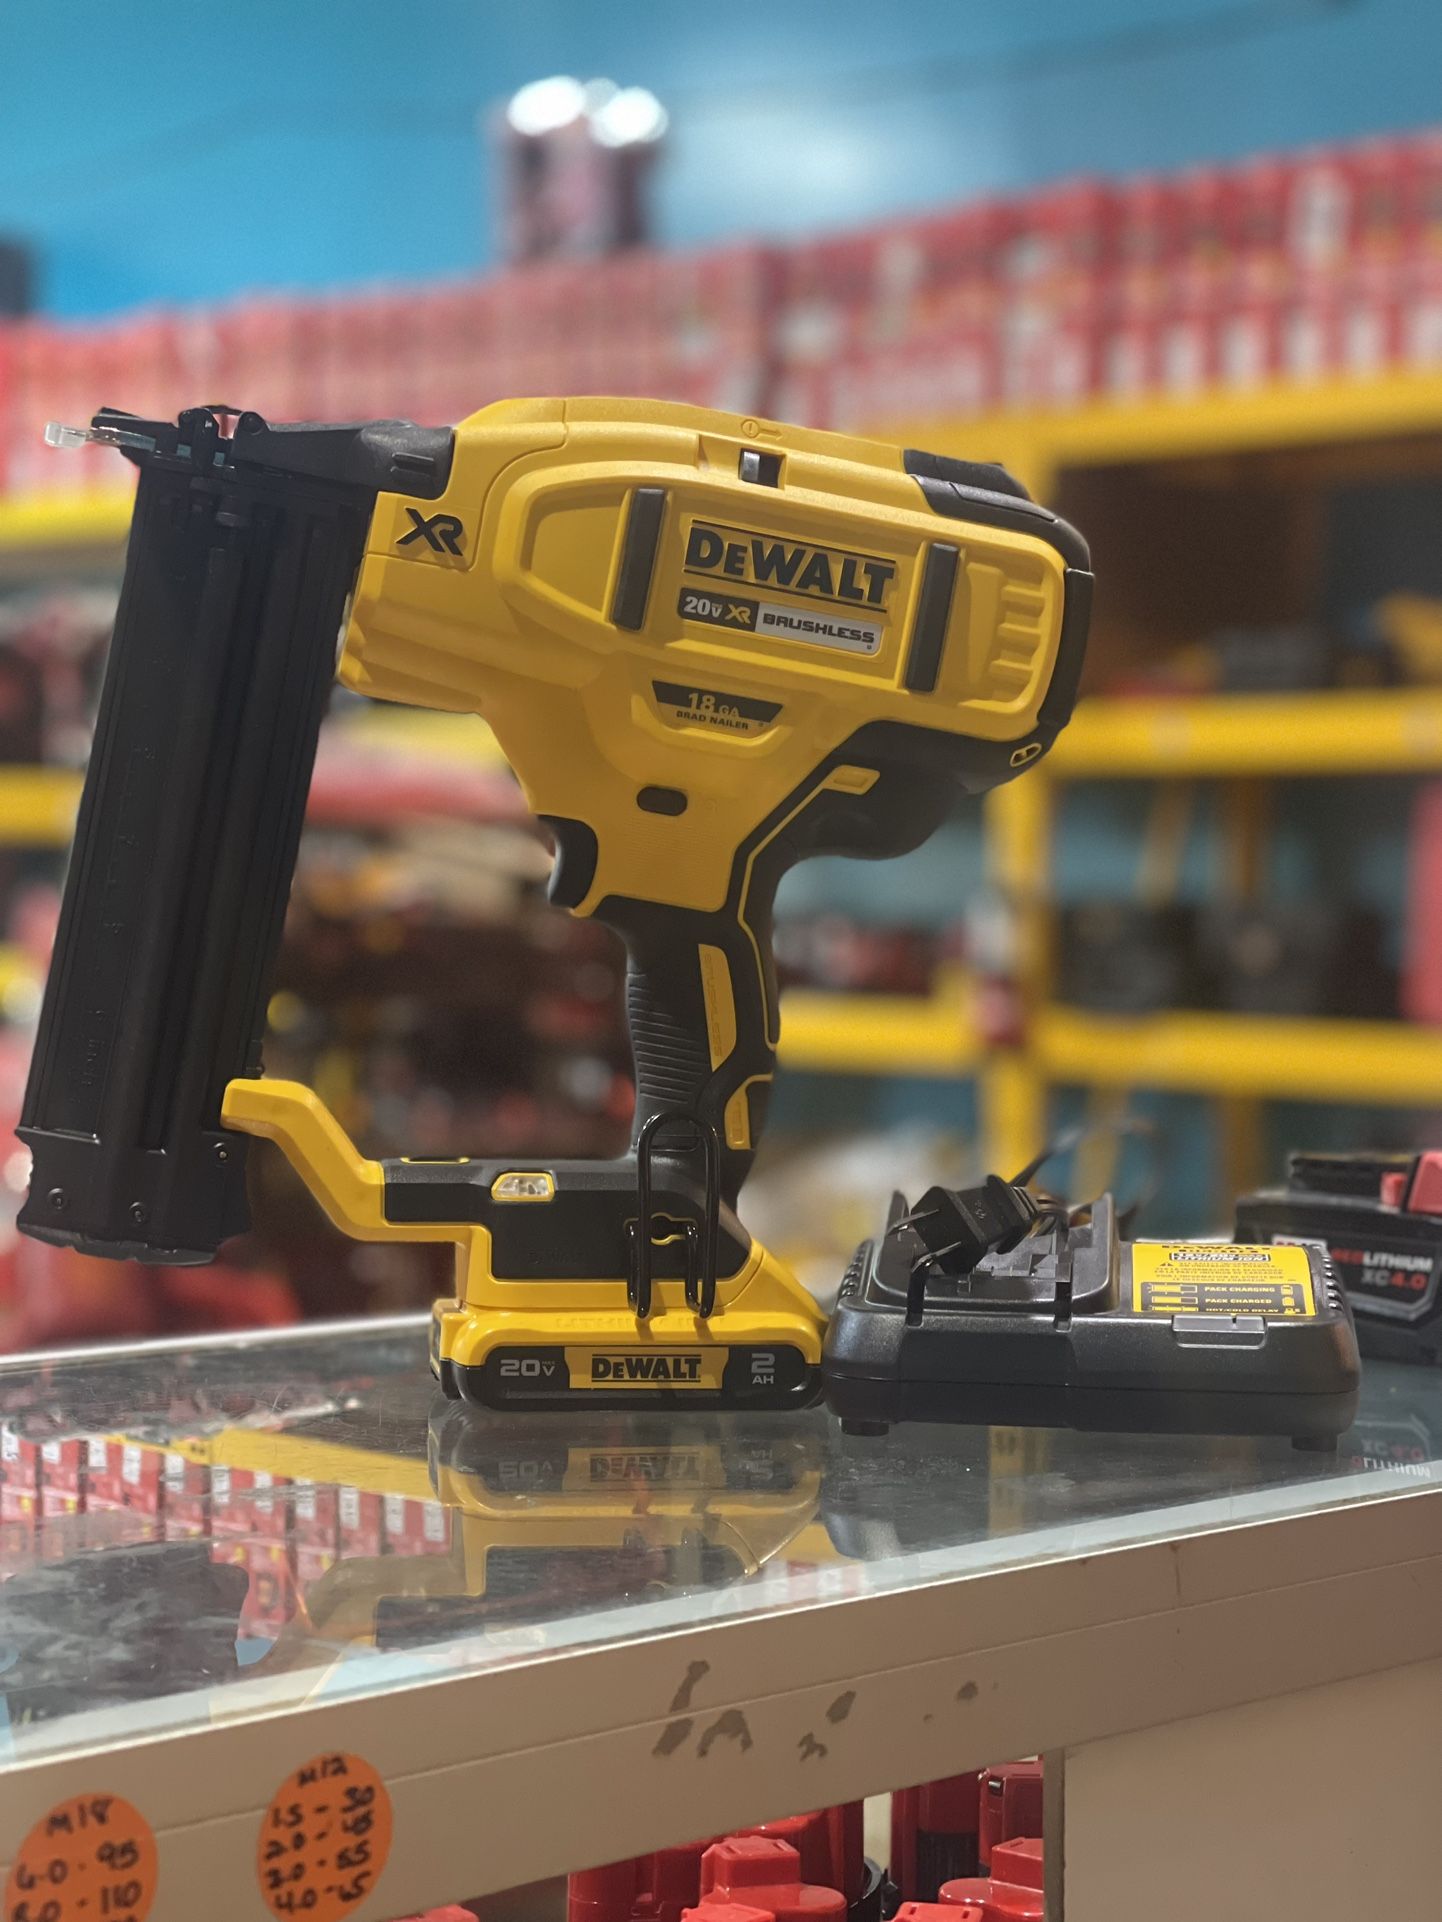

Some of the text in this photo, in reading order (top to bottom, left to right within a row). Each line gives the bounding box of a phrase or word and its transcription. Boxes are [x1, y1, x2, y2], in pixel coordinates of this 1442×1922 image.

[395, 507, 463, 556] XR
[684, 526, 895, 604] DEWALT
[724, 603, 751, 625] XR
[762, 612, 875, 644] BRUSHLESS
[688, 692, 741, 718] 18 GA
[676, 709, 749, 730] BRAD NAILER
[591, 1357, 702, 1380] DEWALT
[752, 1353, 775, 1373] 2
[752, 1376, 774, 1385] AH
[298, 1756, 347, 1787] M12
